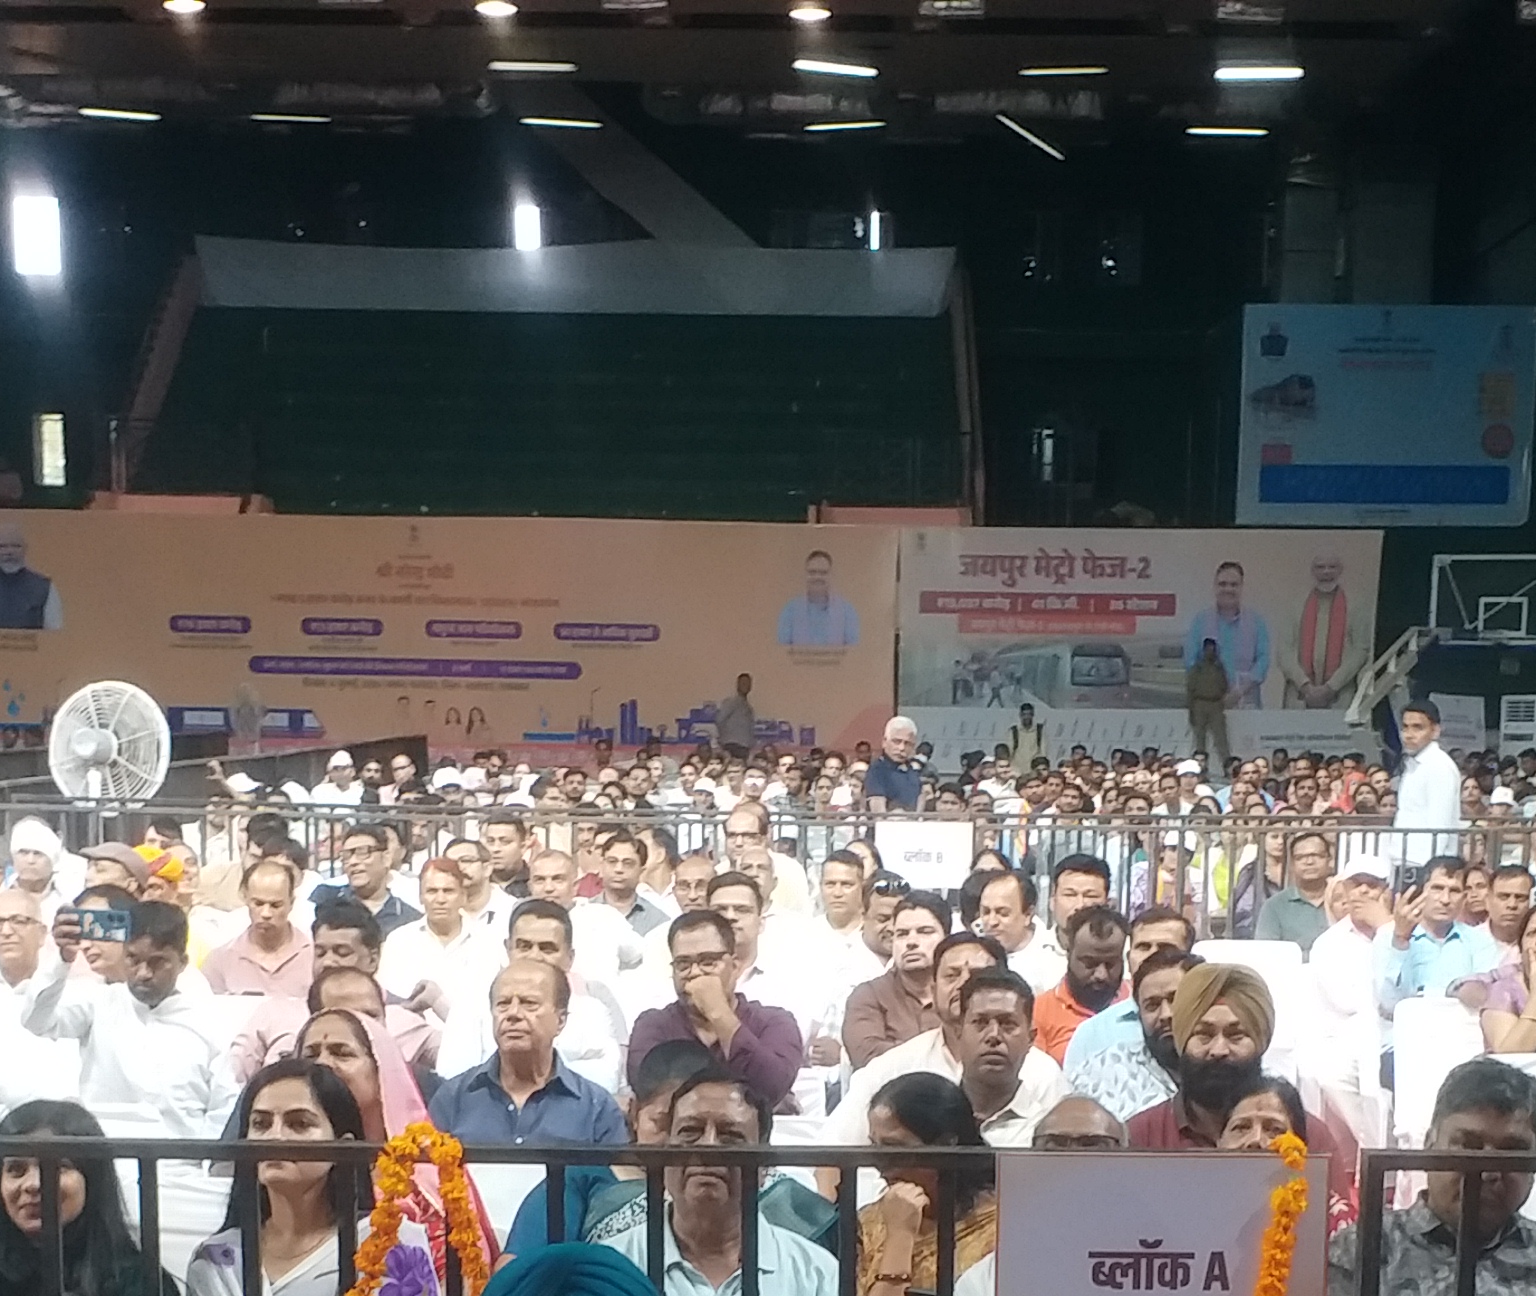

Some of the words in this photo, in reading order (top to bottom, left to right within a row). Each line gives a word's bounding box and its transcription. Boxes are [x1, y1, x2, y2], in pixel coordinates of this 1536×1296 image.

[958, 554, 1029, 587] जयपुर
[1033, 547, 1076, 585] मेट्रो
[1081, 547, 1153, 579] फेज-2
[904, 848, 932, 863] ब्लॉक
[1088, 1237, 1195, 1291] ब्लॉक
[1202, 1251, 1230, 1291] A
